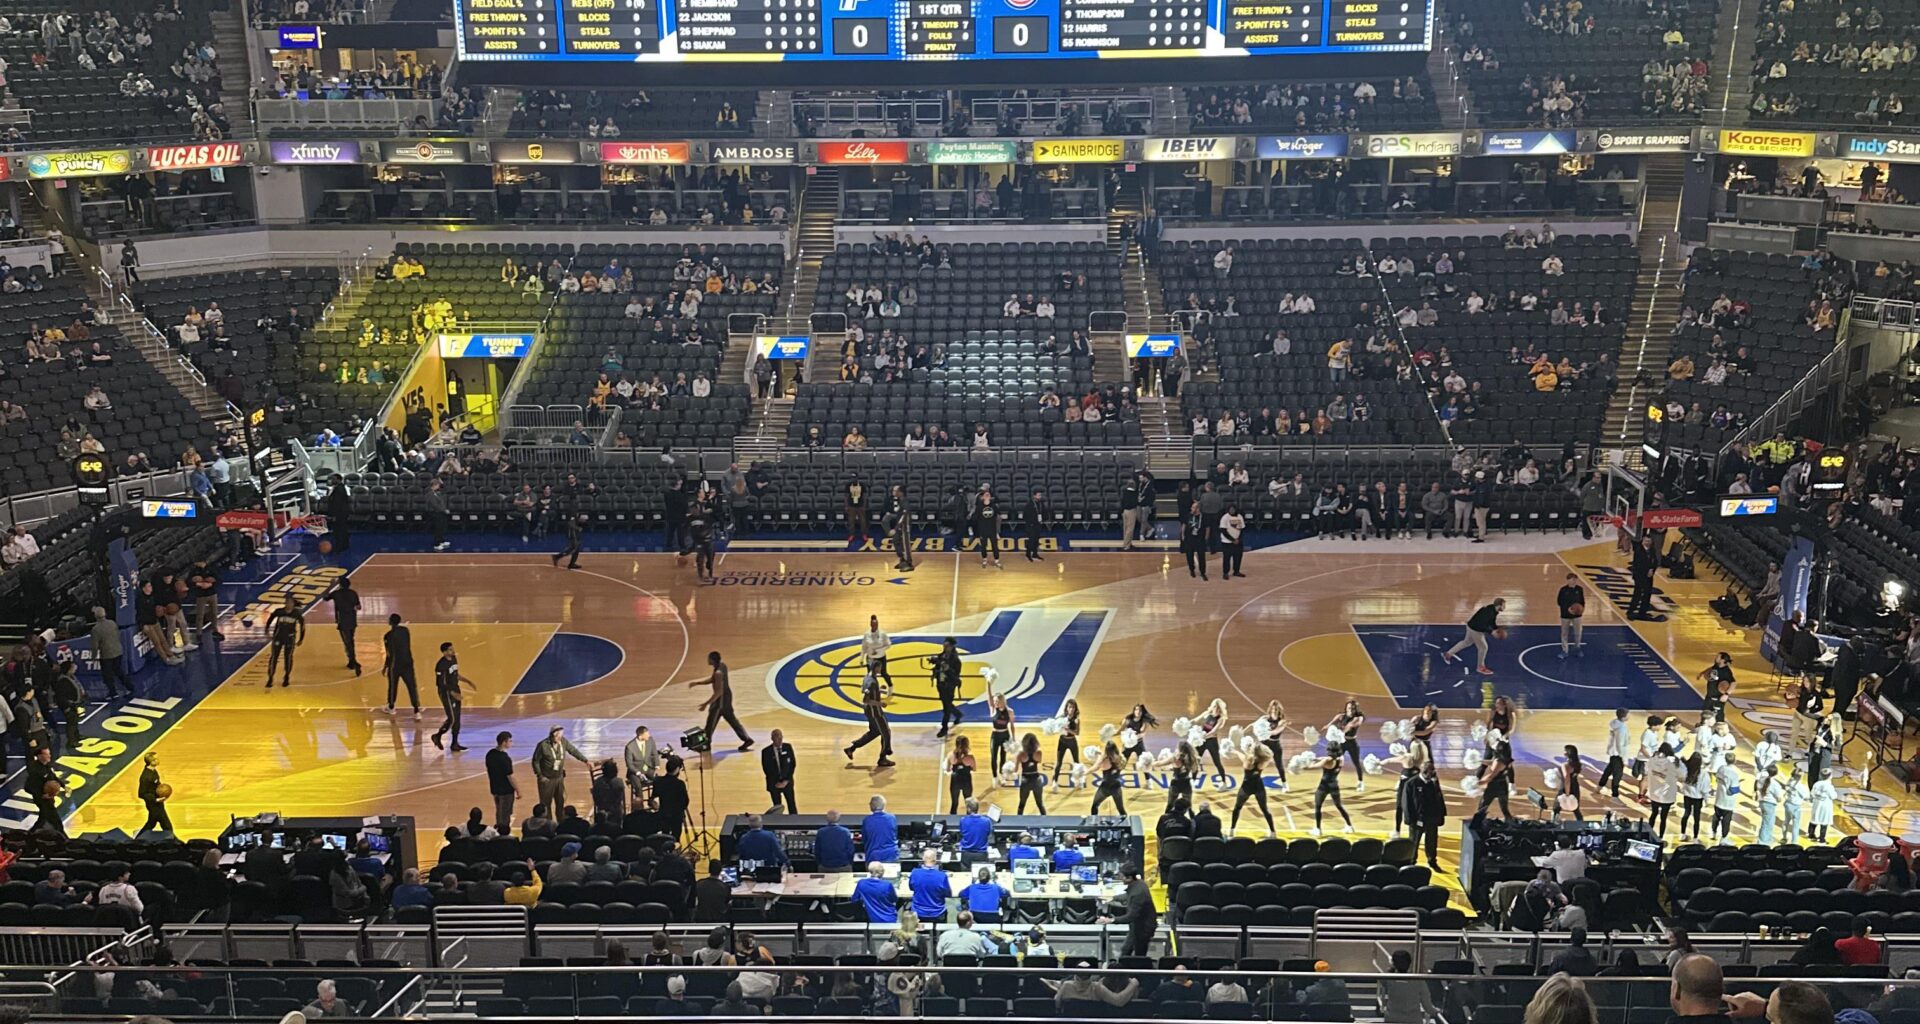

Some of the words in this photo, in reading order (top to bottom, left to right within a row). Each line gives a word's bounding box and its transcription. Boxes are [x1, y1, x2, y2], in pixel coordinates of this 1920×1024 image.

[471, 0, 493, 8] FIELD
[494, 0, 515, 8] GOAL
[1345, 4, 1378, 13] BLOCKS
[919, 4, 938, 15] 1ST
[940, 4, 962, 15] QTR
[1075, 9, 1125, 18] THOMPSON
[1233, 6, 1254, 15] FREE
[1255, 6, 1284, 15] THROW
[470, 13, 489, 22] FREE
[491, 13, 519, 22] THROW
[578, 13, 610, 21] BLOCKS
[679, 13, 690, 22] 22
[691, 13, 731, 22] JACKSON
[922, 21, 958, 29] TIMEOUTS
[962, 21, 968, 29] 7
[1235, 21, 1269, 29] 3-POINT
[1270, 20, 1281, 29] FG
[1345, 18, 1376, 27] STEALS
[474, 27, 505, 35] 3-POINT
[507, 27, 517, 35] FG
[580, 27, 610, 35] STEALS
[692, 27, 736, 36] SHEPPARD
[1063, 24, 1074, 33] 12
[1075, 24, 1107, 33] HARRIS
[852, 25, 868, 47] 0
[928, 32, 952, 40] FOULS
[1013, 23, 1028, 46] 0
[1244, 35, 1279, 43] ASSISTS
[1336, 32, 1384, 41] TURNOVERS
[484, 41, 517, 49] ASSISTS
[572, 41, 620, 50] TURNOVERS
[680, 41, 692, 50] 43
[693, 41, 726, 50] SIAKAM
[925, 43, 956, 51] PENALTY
[1075, 38, 1120, 47] ROBINSON
[1614, 136, 1643, 145] SPORT
[1645, 135, 1690, 144] GRAPHICS
[1728, 132, 1802, 146] Koorsen
[939, 143, 967, 151] Peyton
[969, 142, 1004, 151] Manning
[1162, 139, 1218, 153] IBEW
[1291, 137, 1324, 156] Kroger
[1370, 136, 1411, 153] aes
[1415, 142, 1460, 152] Indiana
[1850, 138, 1920, 155] IndyStar
[291, 143, 340, 160] xfinity
[637, 145, 670, 159] mhs
[713, 147, 795, 159] AMBROSE
[844, 143, 880, 163] Lilly
[1052, 144, 1120, 156] GAINBRIDGE
[64, 153, 93, 161] SOUR
[150, 146, 210, 167] LUCAS
[213, 144, 241, 163] OIL
[56, 159, 105, 173] PUNCH
[482, 337, 524, 346] TUNNEL
[490, 346, 516, 355] CAM
[701, 576, 875, 586] GAINBRIDGE
[101, 696, 183, 734] OIL
[1872, 853, 1882, 862] G
